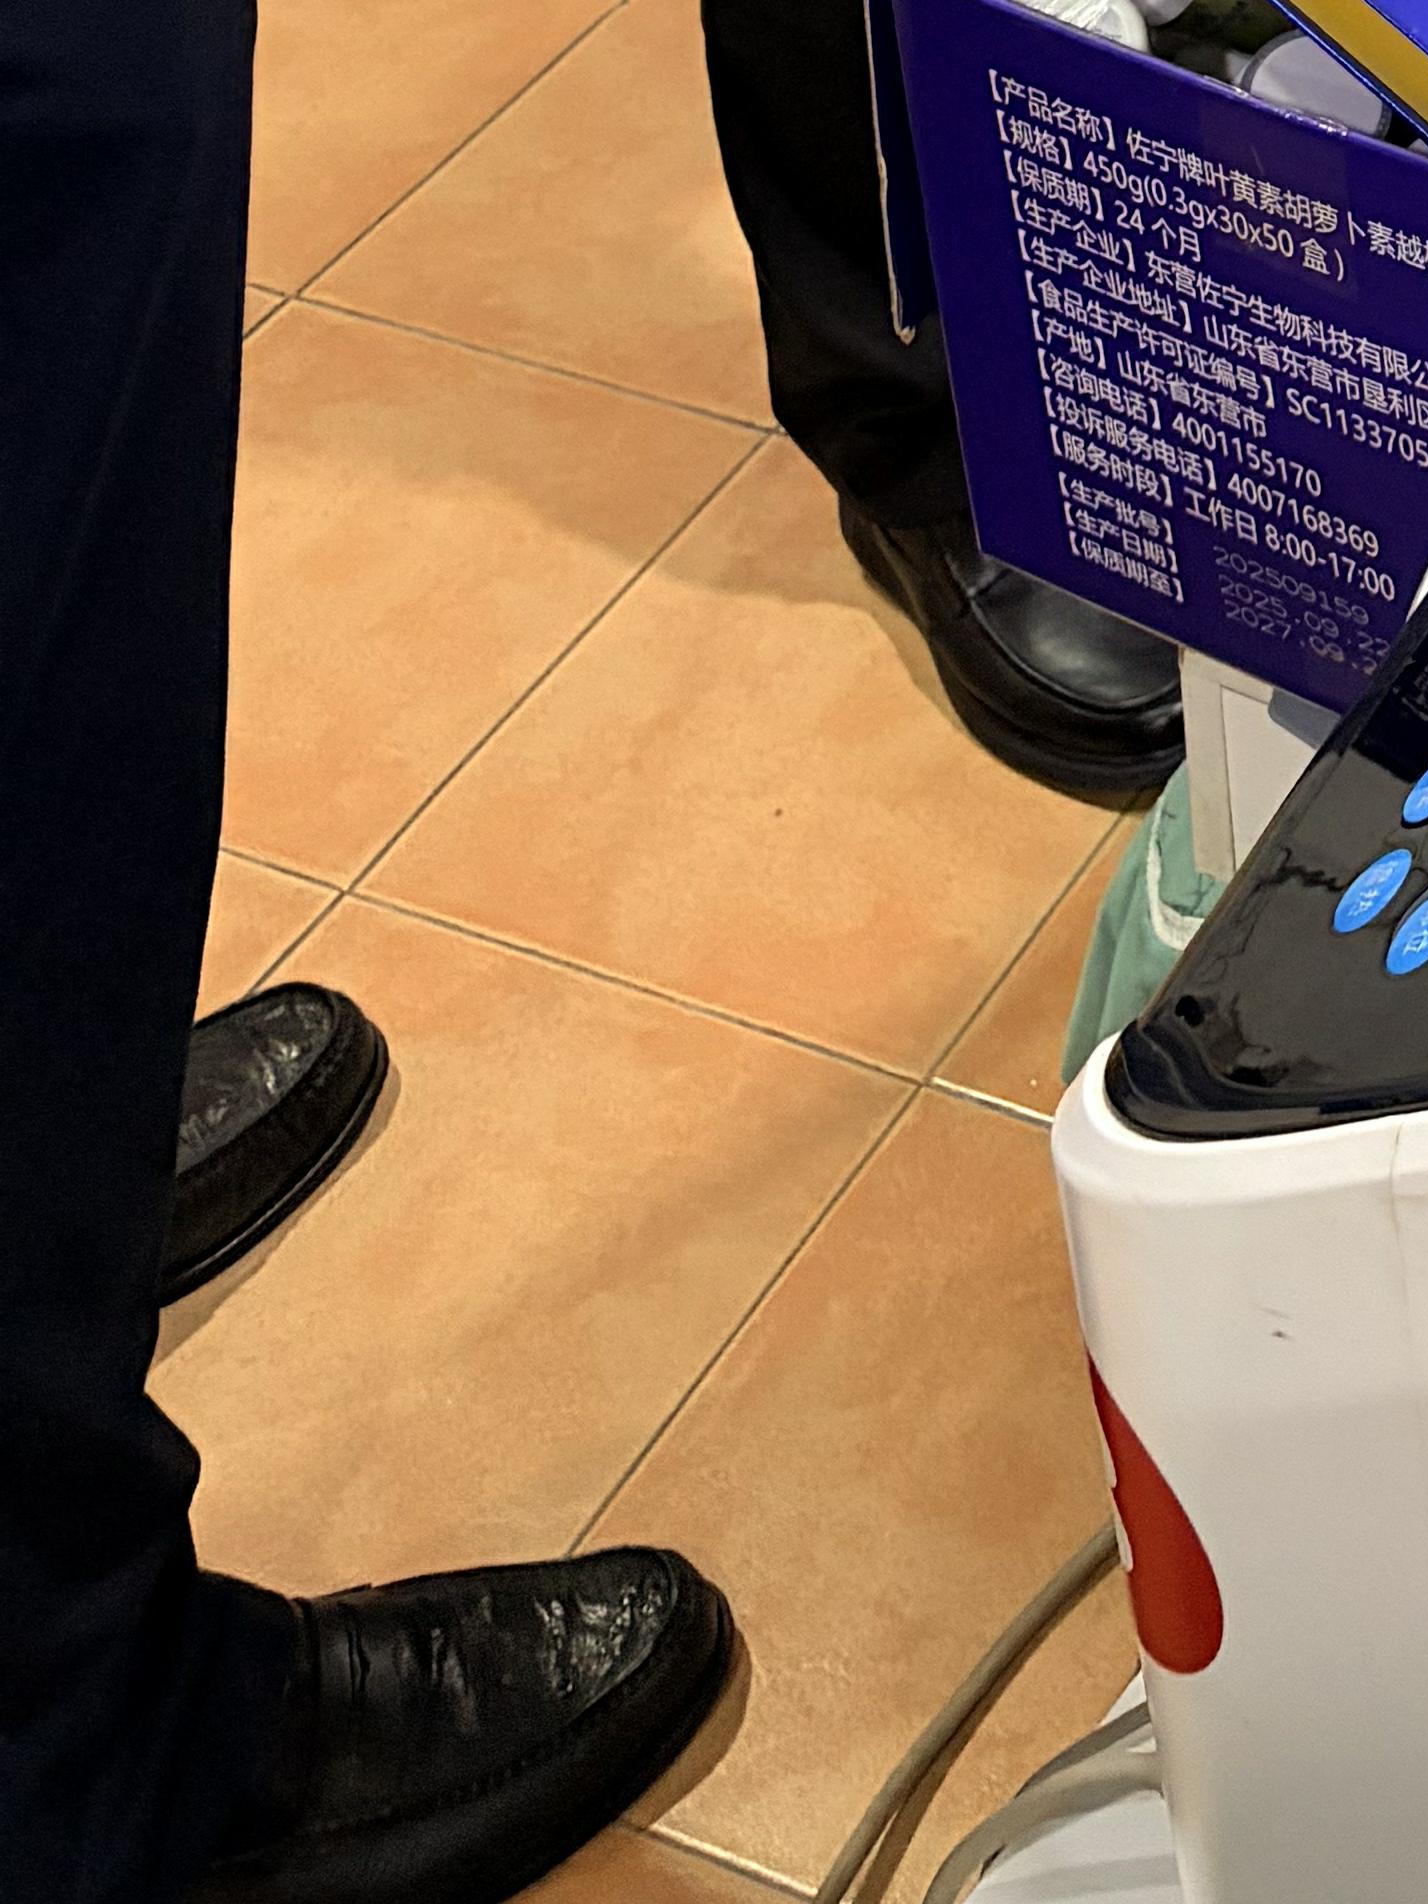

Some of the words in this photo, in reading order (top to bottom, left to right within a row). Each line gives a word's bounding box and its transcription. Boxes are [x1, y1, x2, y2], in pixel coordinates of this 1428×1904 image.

[1058, 472, 1174, 545] 【生产批号】
[1063, 502, 1179, 575] 【生产日期】
[1068, 531, 1185, 604] 【保质期至】
